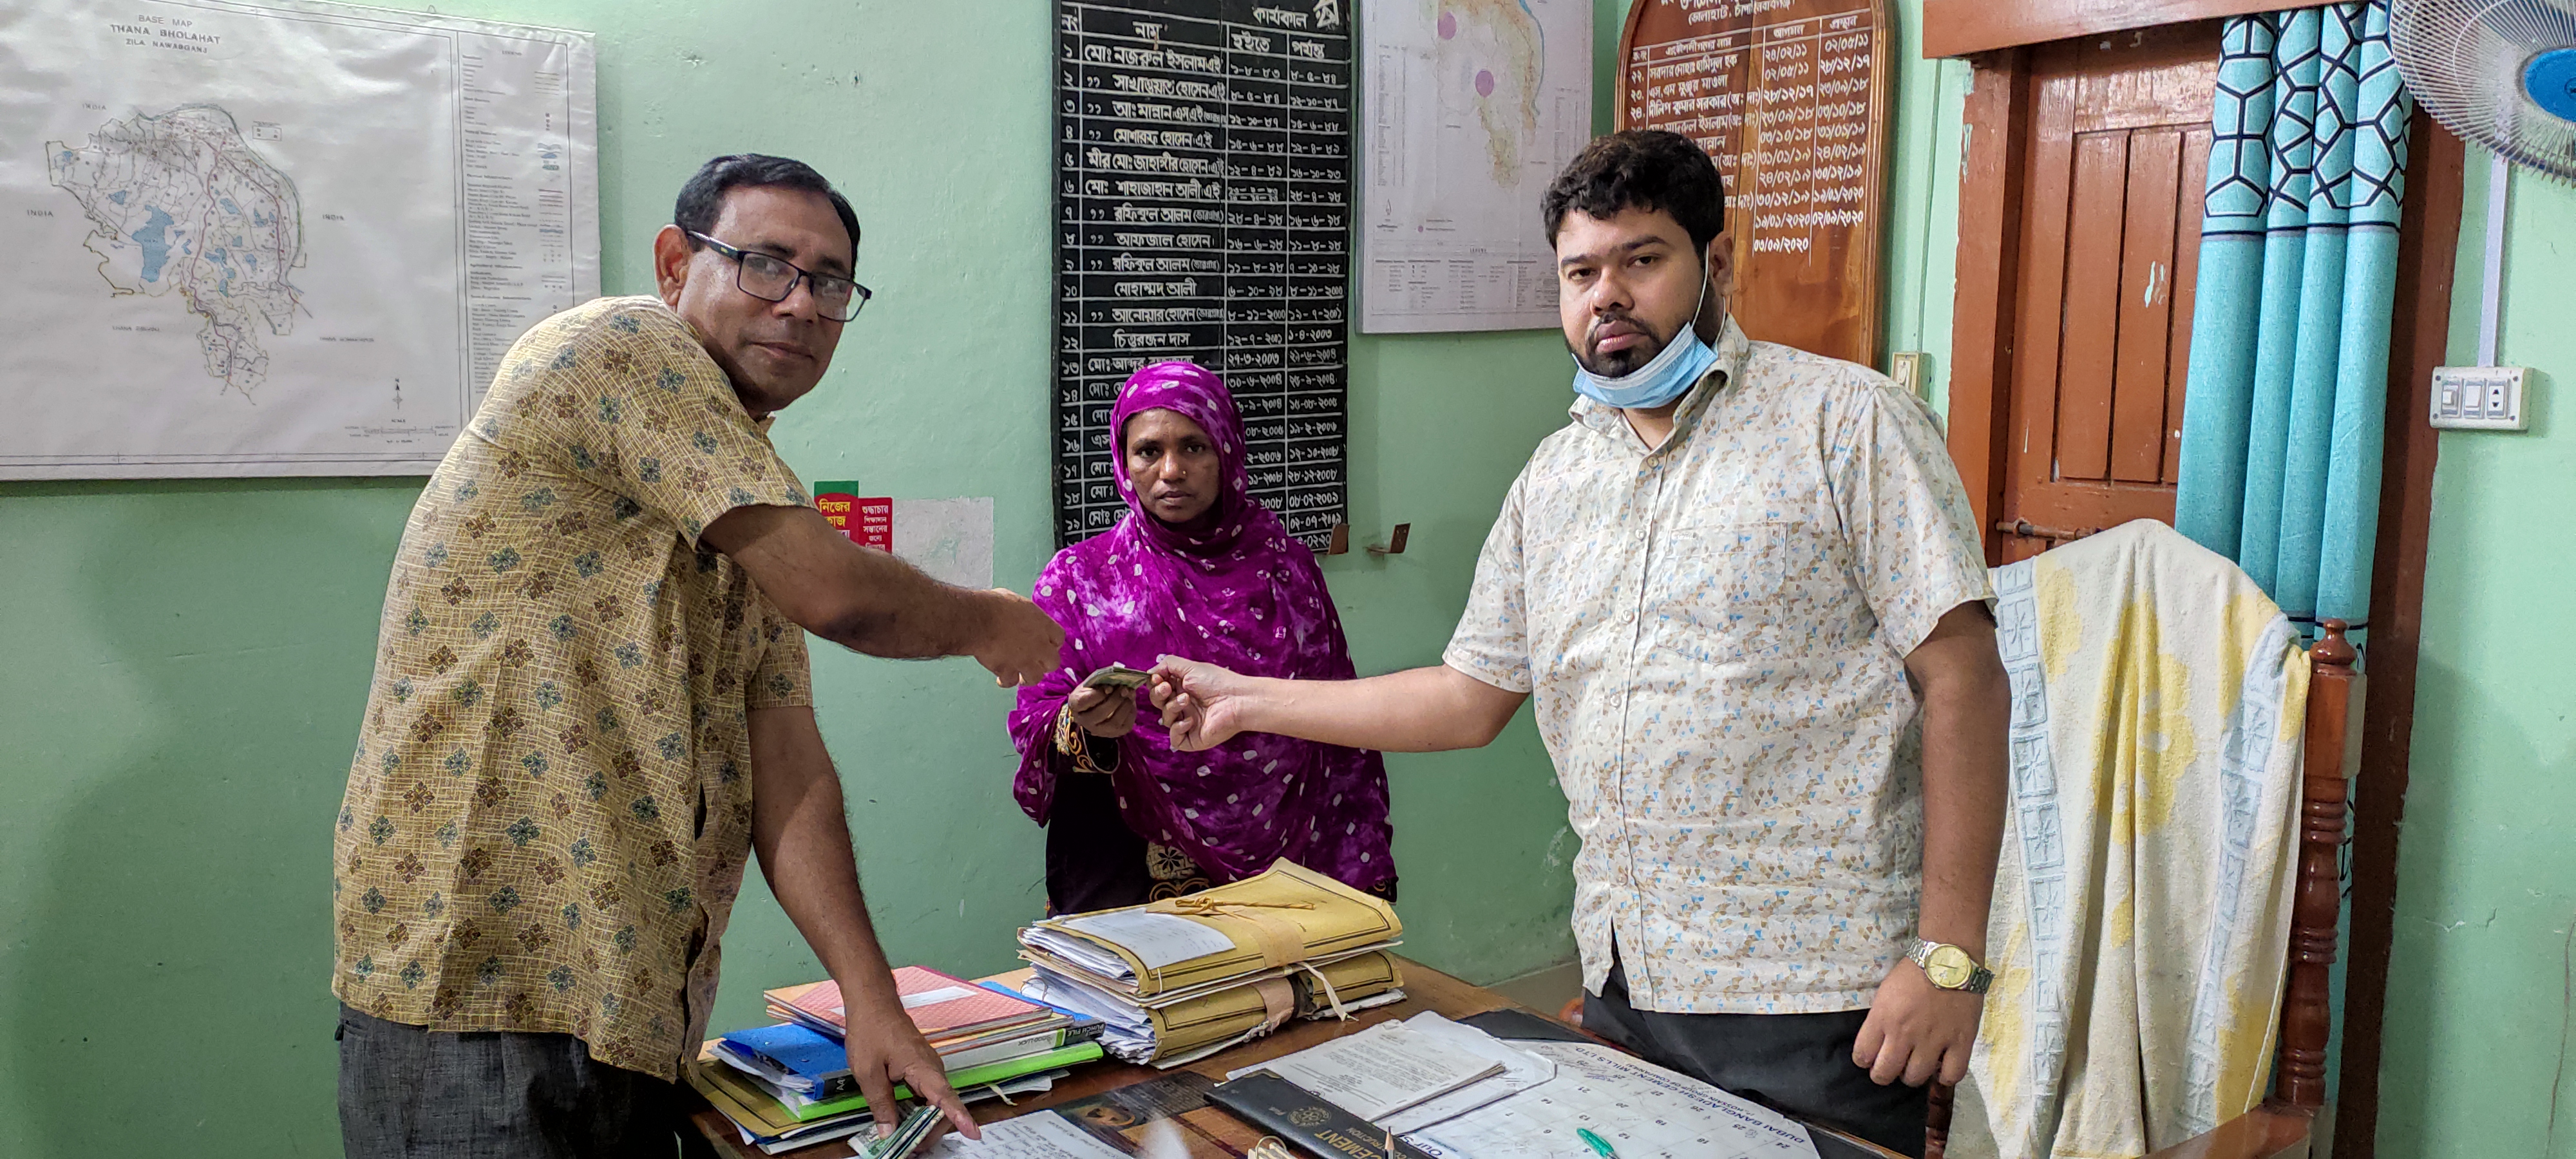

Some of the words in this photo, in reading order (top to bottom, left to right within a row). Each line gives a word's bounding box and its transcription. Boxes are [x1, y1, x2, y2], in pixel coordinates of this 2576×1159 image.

[138, 14, 164, 24] BASE
[172, 18, 193, 27] MAP
[1253, 5, 1309, 30] কার্যকাল
[110, 24, 151, 35] THANA
[160, 29, 220, 44] BHOLAHAT
[1062, 13, 1078, 31] নং
[1132, 21, 1162, 40] নাম
[1231, 30, 1271, 52] হইতে
[152, 41, 207, 53] NAWABGANJ
[1063, 43, 1073, 58] ১
[1113, 46, 1164, 68] নজরুল
[1649, 64, 1675, 80] সরদার
[1765, 43, 1807, 63] ২৪/০২/১১
[1825, 33, 1868, 54] ০২/০৫/১১
[1701, 74, 1728, 90] মাওলা
[1765, 61, 1809, 82] ০২/০৫/১১
[1820, 53, 1870, 76] ২৮/১২/১৭
[1063, 70, 1074, 88] ২
[1176, 81, 1210, 99] হোসেন
[1063, 99, 1075, 113] ৩
[1672, 98, 1695, 115] কুমার
[1763, 84, 1814, 105] ২৮/১২/১৭
[1819, 77, 1870, 99] ২৩/০৯/১৮
[1761, 106, 1814, 127] ২৩/০৯/১৮
[1817, 100, 1866, 122] ০৩/১০/১৮
[1065, 125, 1073, 140] ৪
[1113, 128, 1159, 146] মোশারফ
[1160, 131, 1193, 148] হোসেন
[1760, 126, 1813, 146] ০৩/১০/১৮
[1817, 121, 1866, 140] ৩১/০১/১৯
[1065, 151, 1074, 167] ৫
[1086, 147, 1112, 169] মীর
[1133, 151, 1179, 172] জাহাঙ্গীর
[1179, 158, 1209, 173] হোসেন
[1759, 147, 1812, 167] ৩১/০১/১৯
[1816, 141, 1866, 162] ২৪/০২/১৯
[1759, 168, 1811, 188] ২৪/০২/১৯
[1815, 164, 1863, 182] ৩০/১২/১৯
[1064, 179, 1074, 193] ৬
[1115, 180, 1175, 197] শাহাজাহান
[1175, 178, 1202, 198] আলী
[1756, 189, 1810, 209] ৩০/১২/১৯
[1814, 185, 1864, 204] ১৯/০১/২০২০
[27, 209, 54, 218] INDIA
[1065, 205, 1072, 220] ৭
[1113, 202, 1160, 223] রফিকুল
[1160, 207, 1191, 223] আলম
[1755, 212, 1810, 231] ১৯/০১/২০২০
[1812, 208, 1864, 229] ০২/০৯/২০২০
[1065, 232, 1075, 246] ৮
[1113, 232, 1175, 248] আফজাল
[1754, 236, 1809, 254] ০৩/০৯/২০২০
[1065, 259, 1074, 271] ৯
[1112, 252, 1155, 272] রফিকুল
[1155, 258, 1190, 272] আলম
[1063, 284, 1077, 297] ১০
[1114, 281, 1164, 297] মোহাম্মদ
[1165, 277, 1198, 297] আলী
[1063, 310, 1077, 324] ১১
[1112, 308, 1165, 323] আনোয়ার
[1165, 307, 1196, 321] হোসেন
[1063, 335, 1079, 350] ১২
[1168, 333, 1191, 346] দাস
[1062, 361, 1079, 374] ১৩
[1063, 389, 1078, 402] ১৪
[1063, 413, 1078, 427] ১৫
[1063, 438, 1080, 452] ১৬
[1064, 464, 1077, 478] ১৭
[819, 498, 851, 513] নিজের
[1064, 492, 1081, 505] ১৮
[1065, 518, 1081, 531] ১৯
[1067, 1028, 1081, 1037] FILE
[1081, 1023, 1104, 1033] PUNCH
[1596, 1056, 1630, 1073] MILLS
[837, 1079, 846, 1091] A4
[1630, 1071, 1678, 1092] CEMENT
[1678, 1089, 1763, 1126] BANGLADESH
[1763, 1124, 1805, 1144] DUBAI
[1414, 1142, 1443, 1156] Our
